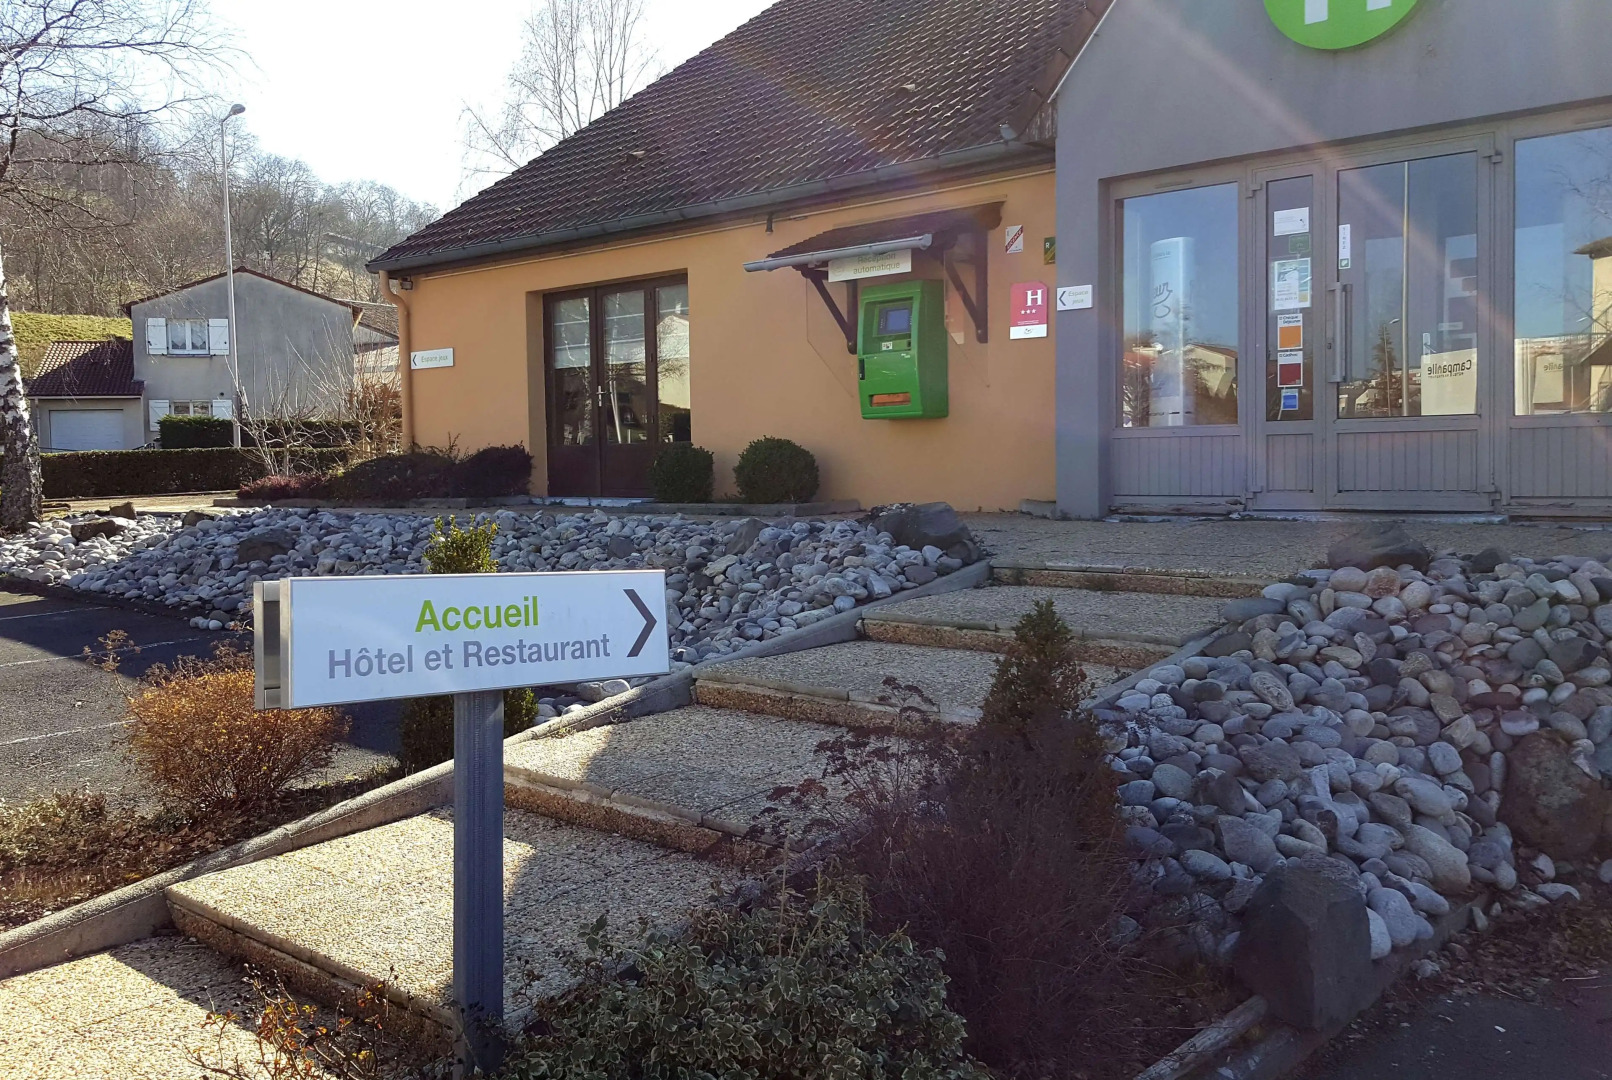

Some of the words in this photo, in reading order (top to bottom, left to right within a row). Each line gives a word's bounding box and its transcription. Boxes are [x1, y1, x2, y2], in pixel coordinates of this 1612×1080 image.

[853, 262, 900, 275] automatique
[1025, 289, 1044, 307] H
[415, 596, 540, 633] Accueil
[328, 645, 414, 679] Hôtel
[424, 643, 454, 671] et
[463, 633, 611, 668] Restaurant
